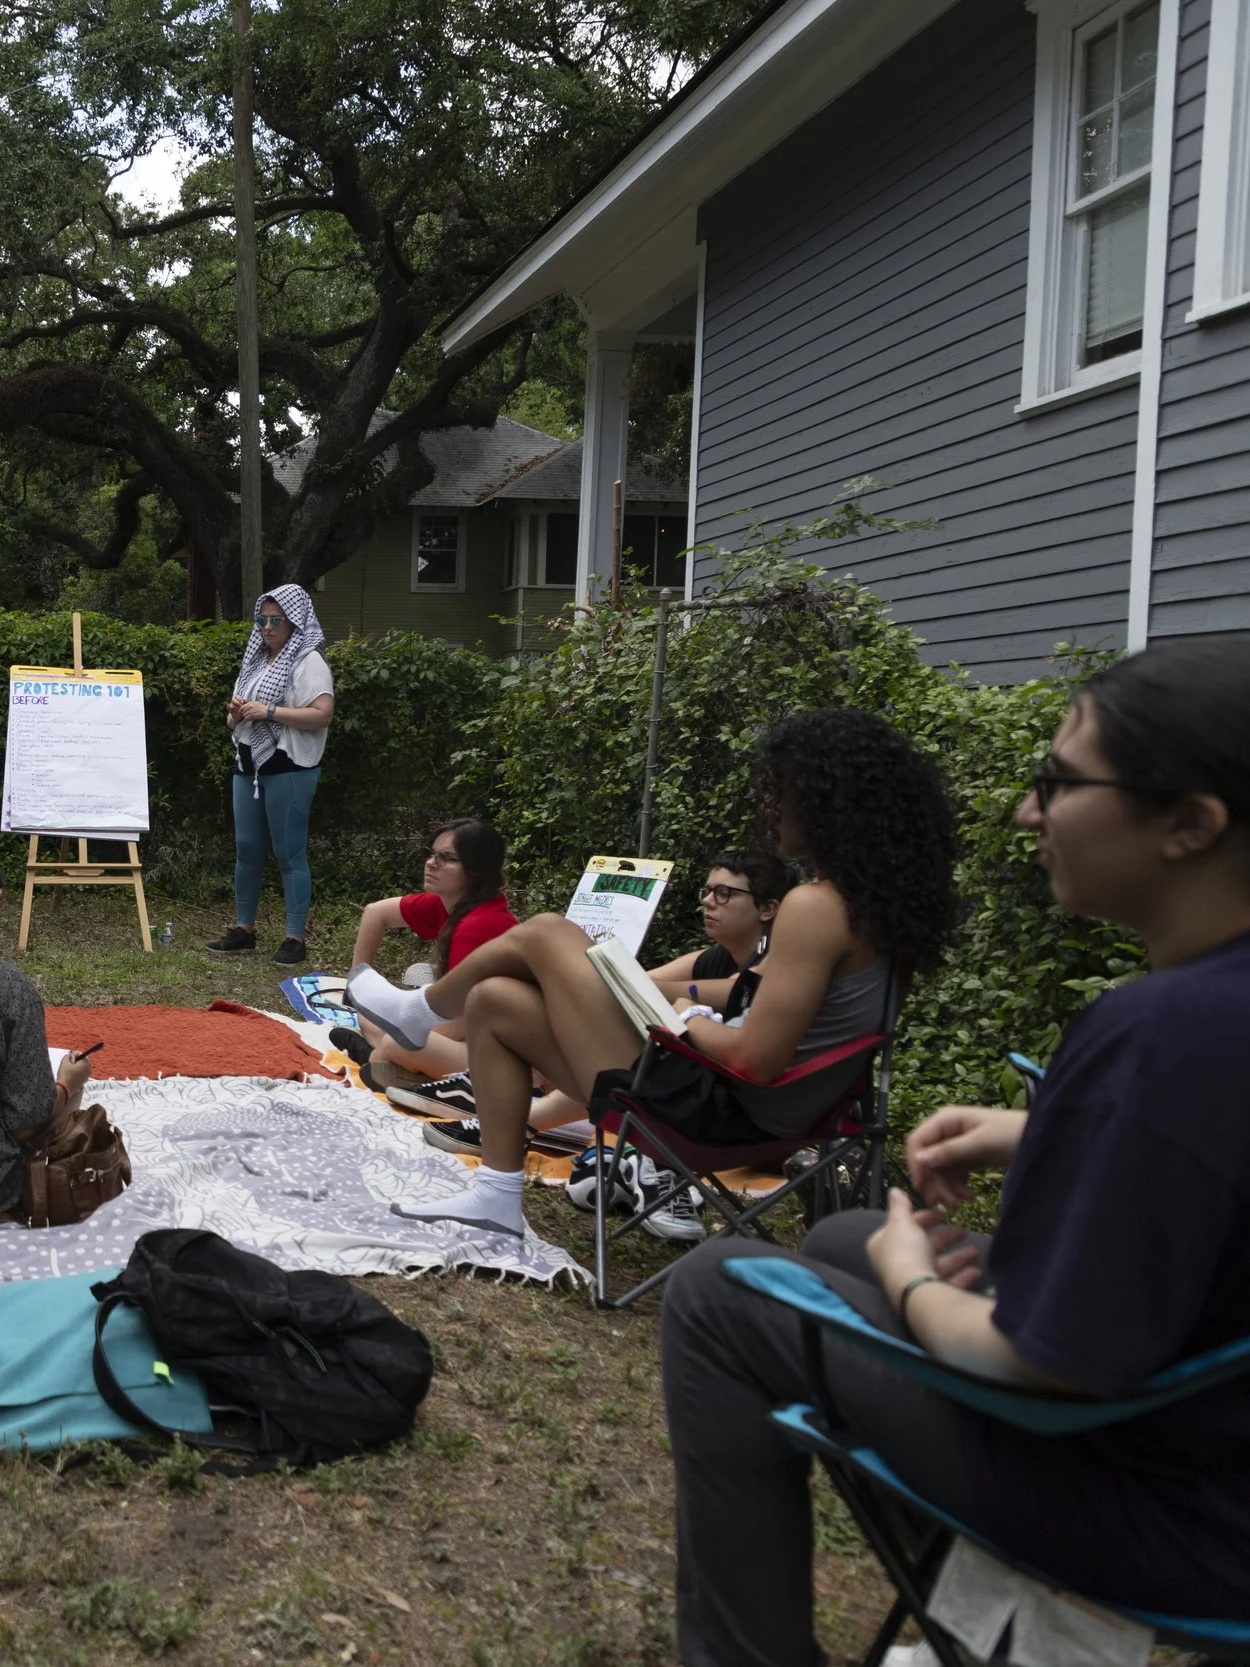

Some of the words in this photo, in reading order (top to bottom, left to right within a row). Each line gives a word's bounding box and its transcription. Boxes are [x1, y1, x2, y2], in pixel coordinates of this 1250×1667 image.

[13, 682, 102, 697] PROTESTING
[107, 685, 130, 698] 101
[12, 695, 49, 705] BEFORE
[598, 874, 651, 898] SAFETY
